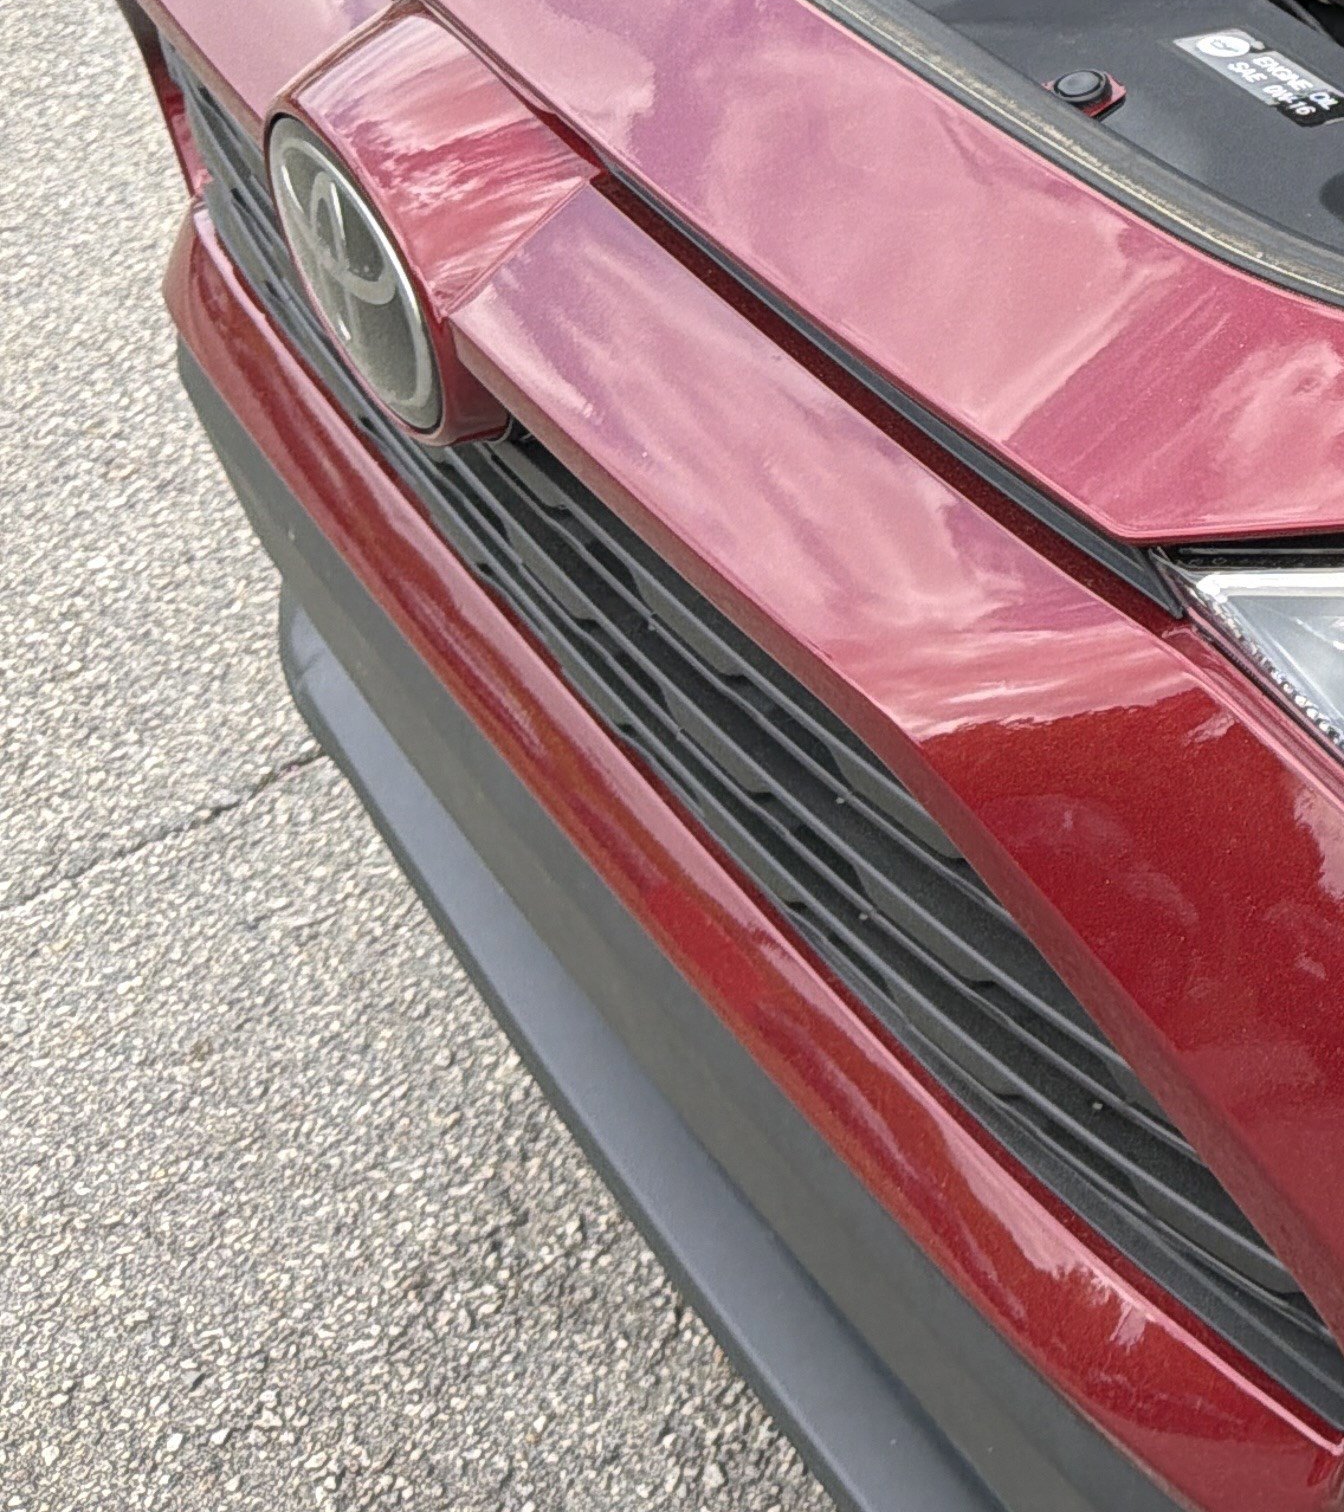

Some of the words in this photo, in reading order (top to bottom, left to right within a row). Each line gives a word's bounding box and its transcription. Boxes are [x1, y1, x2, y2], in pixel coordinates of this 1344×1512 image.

[1228, 61, 1267, 83] SAE
[1262, 85, 1316, 115] 0W-16
[1253, 56, 1314, 91] ENGINE
[1309, 91, 1339, 110] OIL
